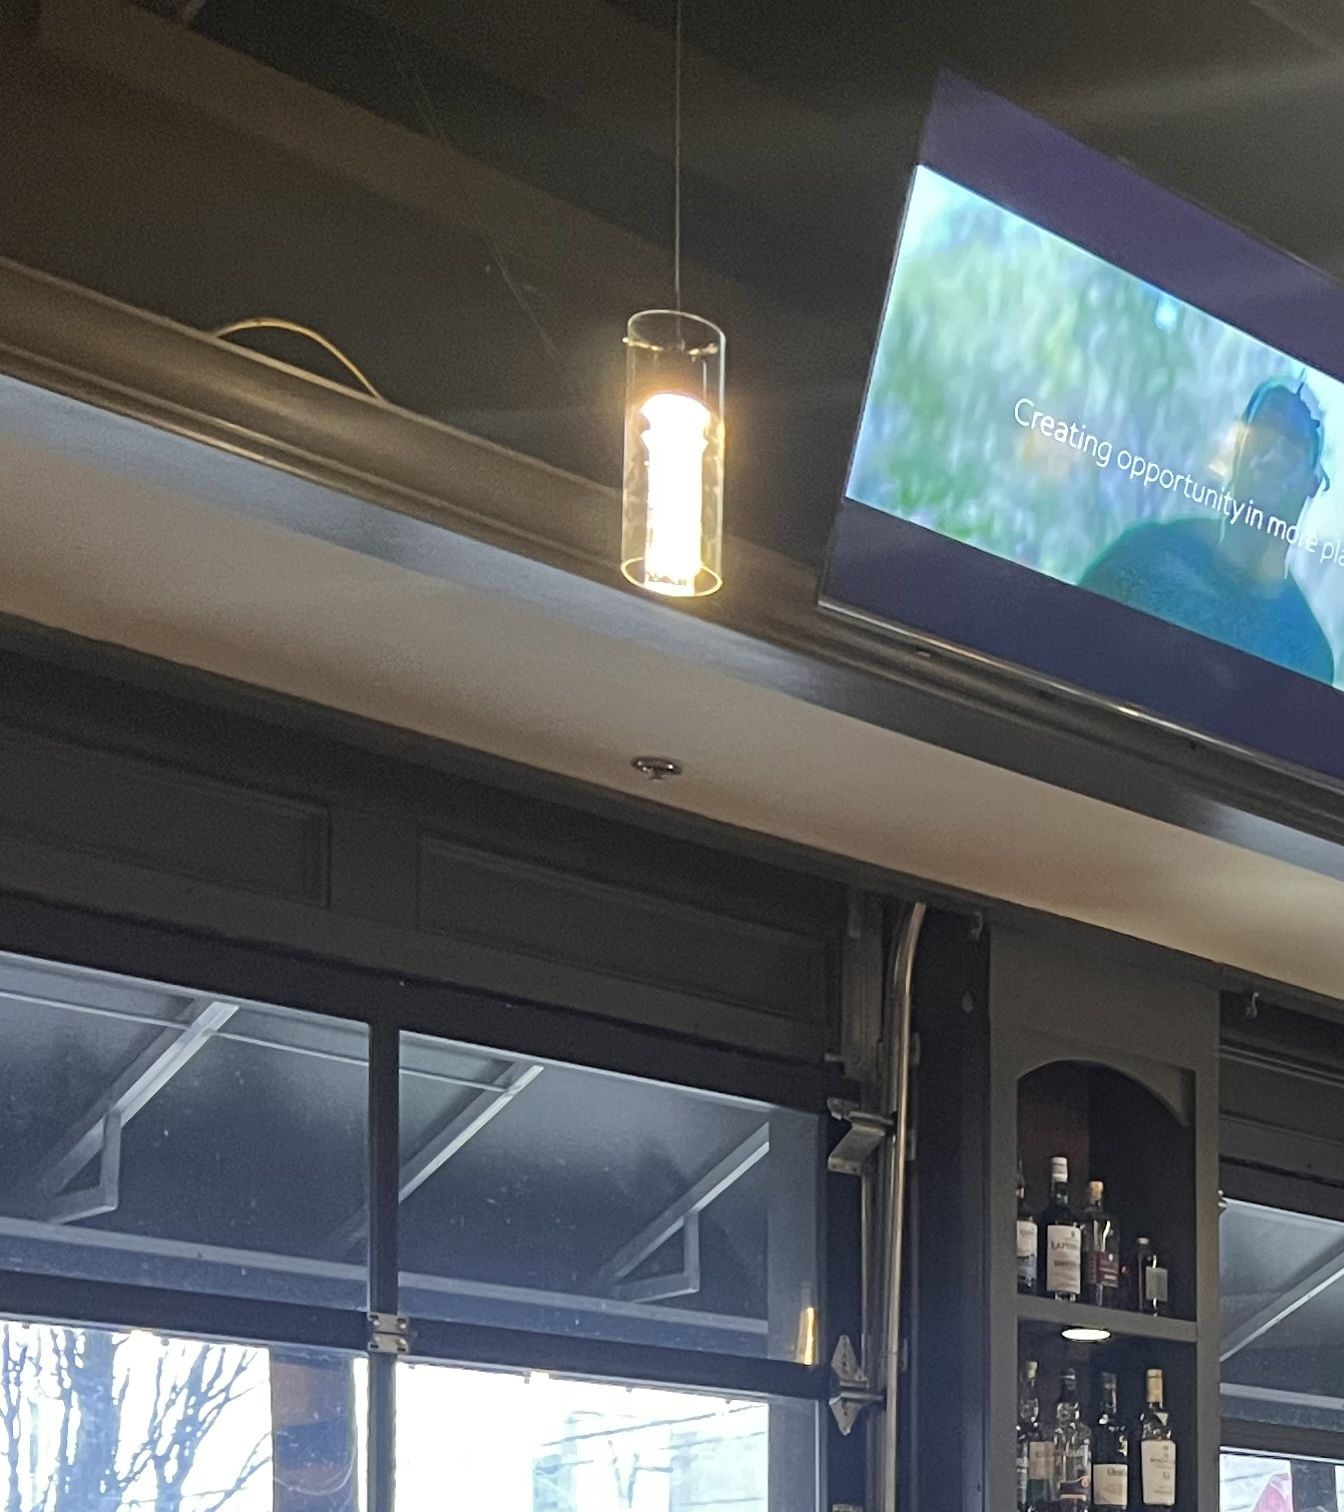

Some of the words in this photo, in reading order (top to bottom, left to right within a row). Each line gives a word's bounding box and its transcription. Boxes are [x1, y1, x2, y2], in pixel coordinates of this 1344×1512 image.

[1013, 398, 1113, 468] Creating
[1116, 448, 1245, 526] opportunity
[1244, 500, 1263, 530] in
[1266, 515, 1318, 553] more
